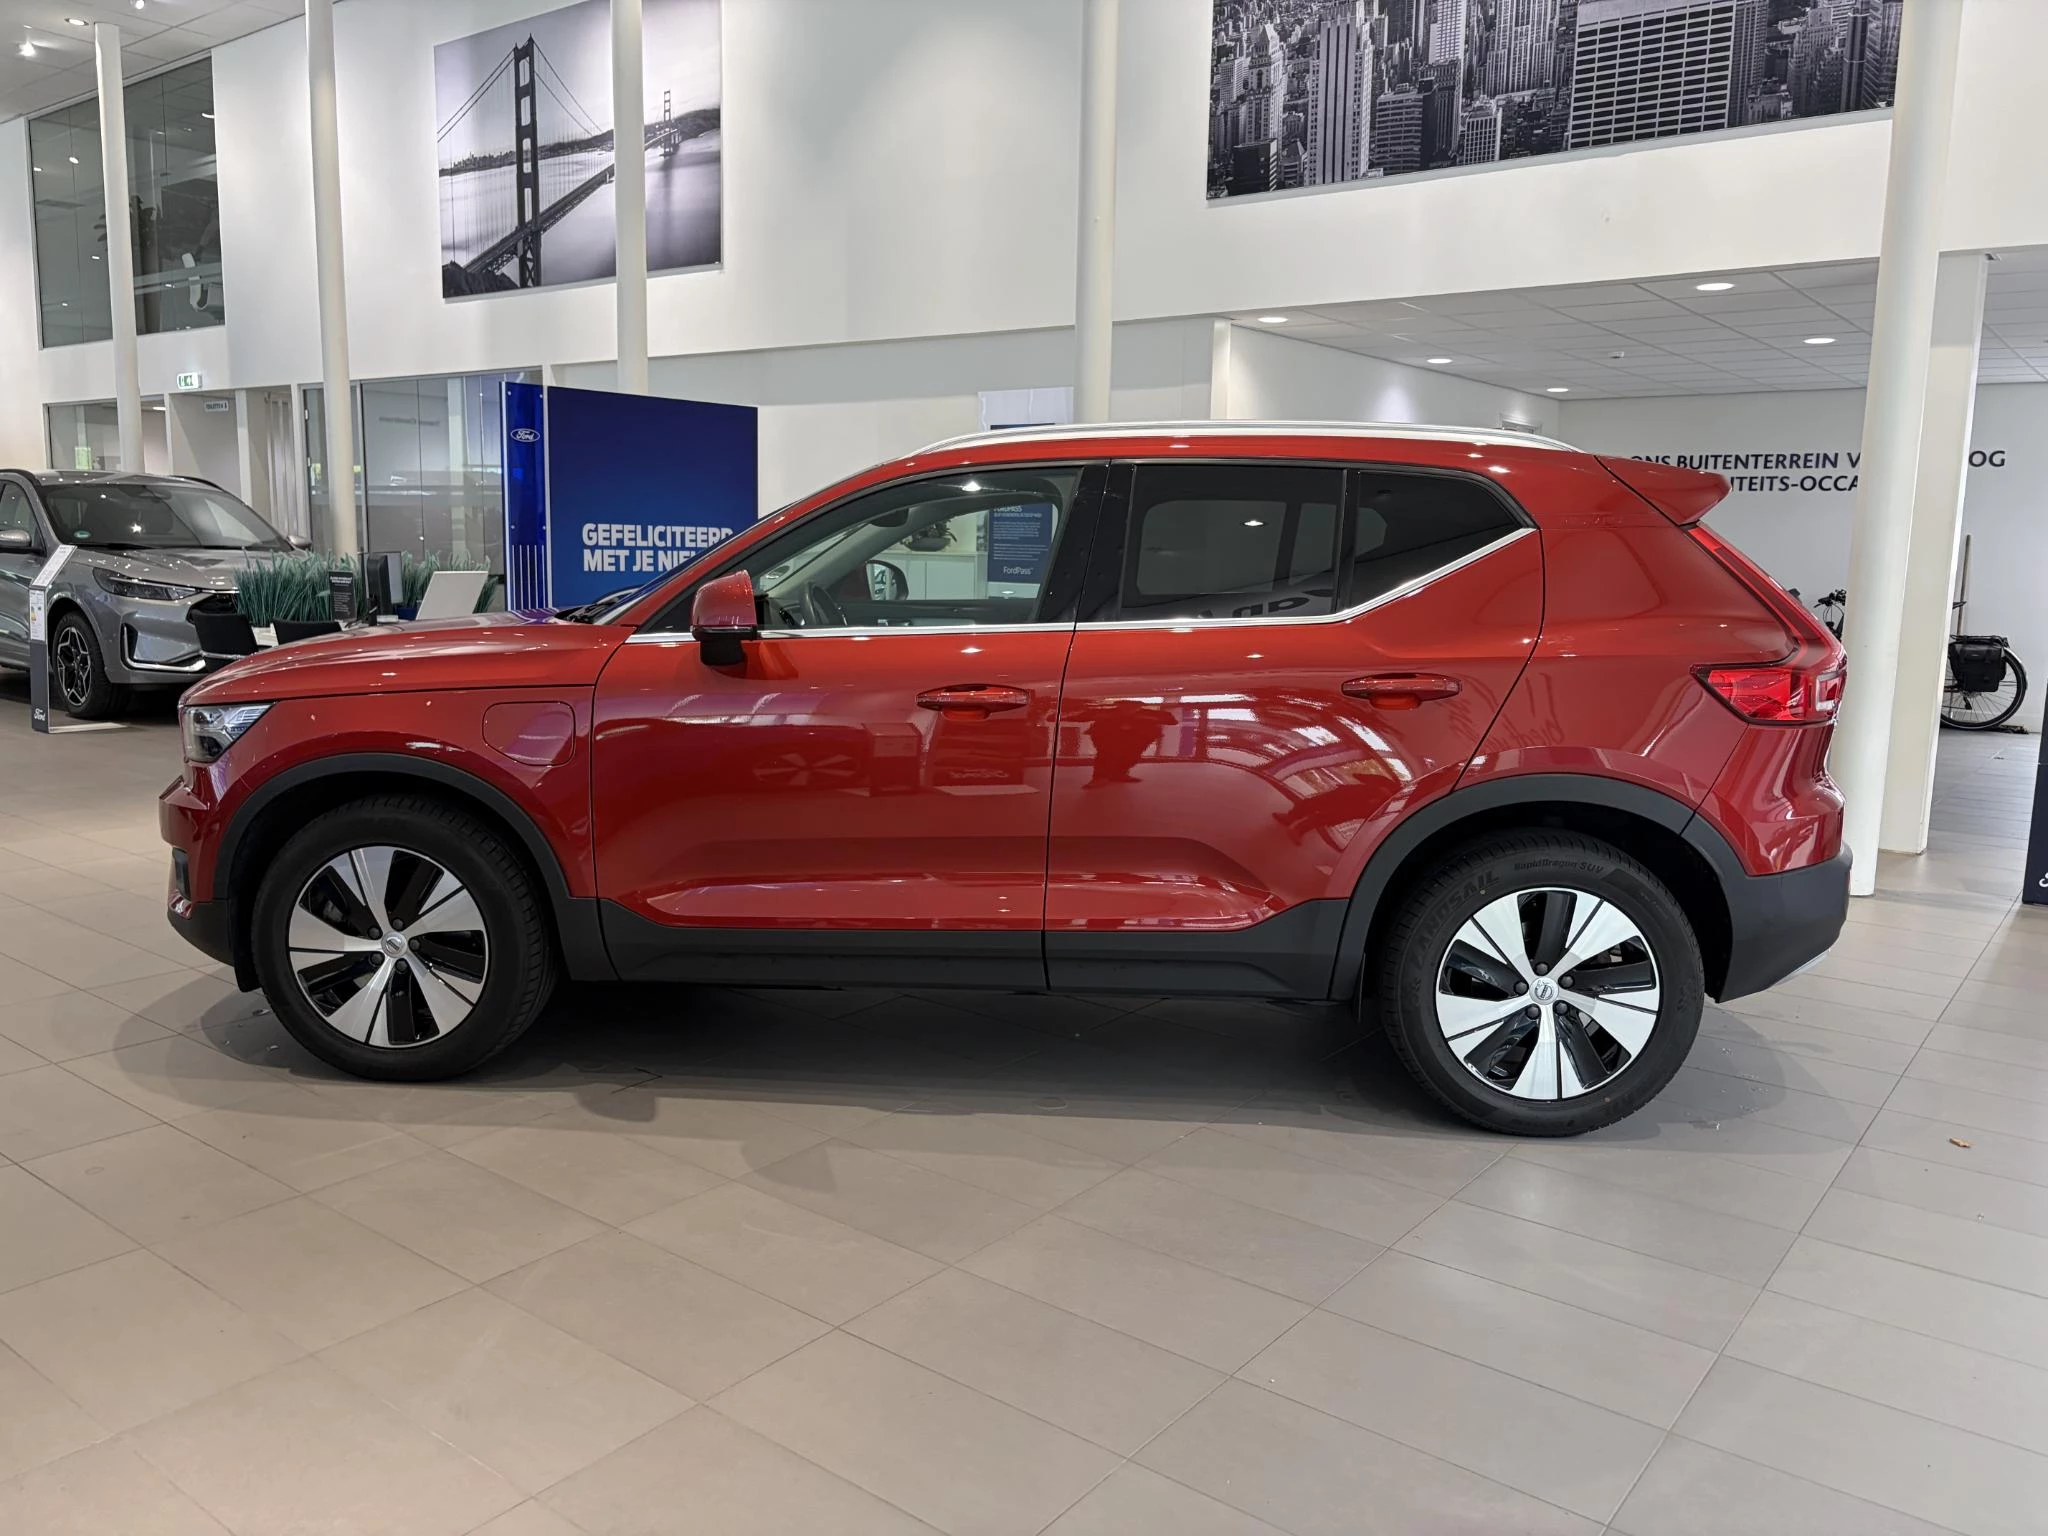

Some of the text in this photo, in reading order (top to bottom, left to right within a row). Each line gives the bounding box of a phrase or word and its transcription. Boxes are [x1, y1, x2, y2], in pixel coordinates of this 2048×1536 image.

[1676, 453, 1839, 470] BUITENTERREIN
[1730, 475, 1859, 492] ITEITS-OCCA
[583, 549, 696, 572] MET JE NIE
